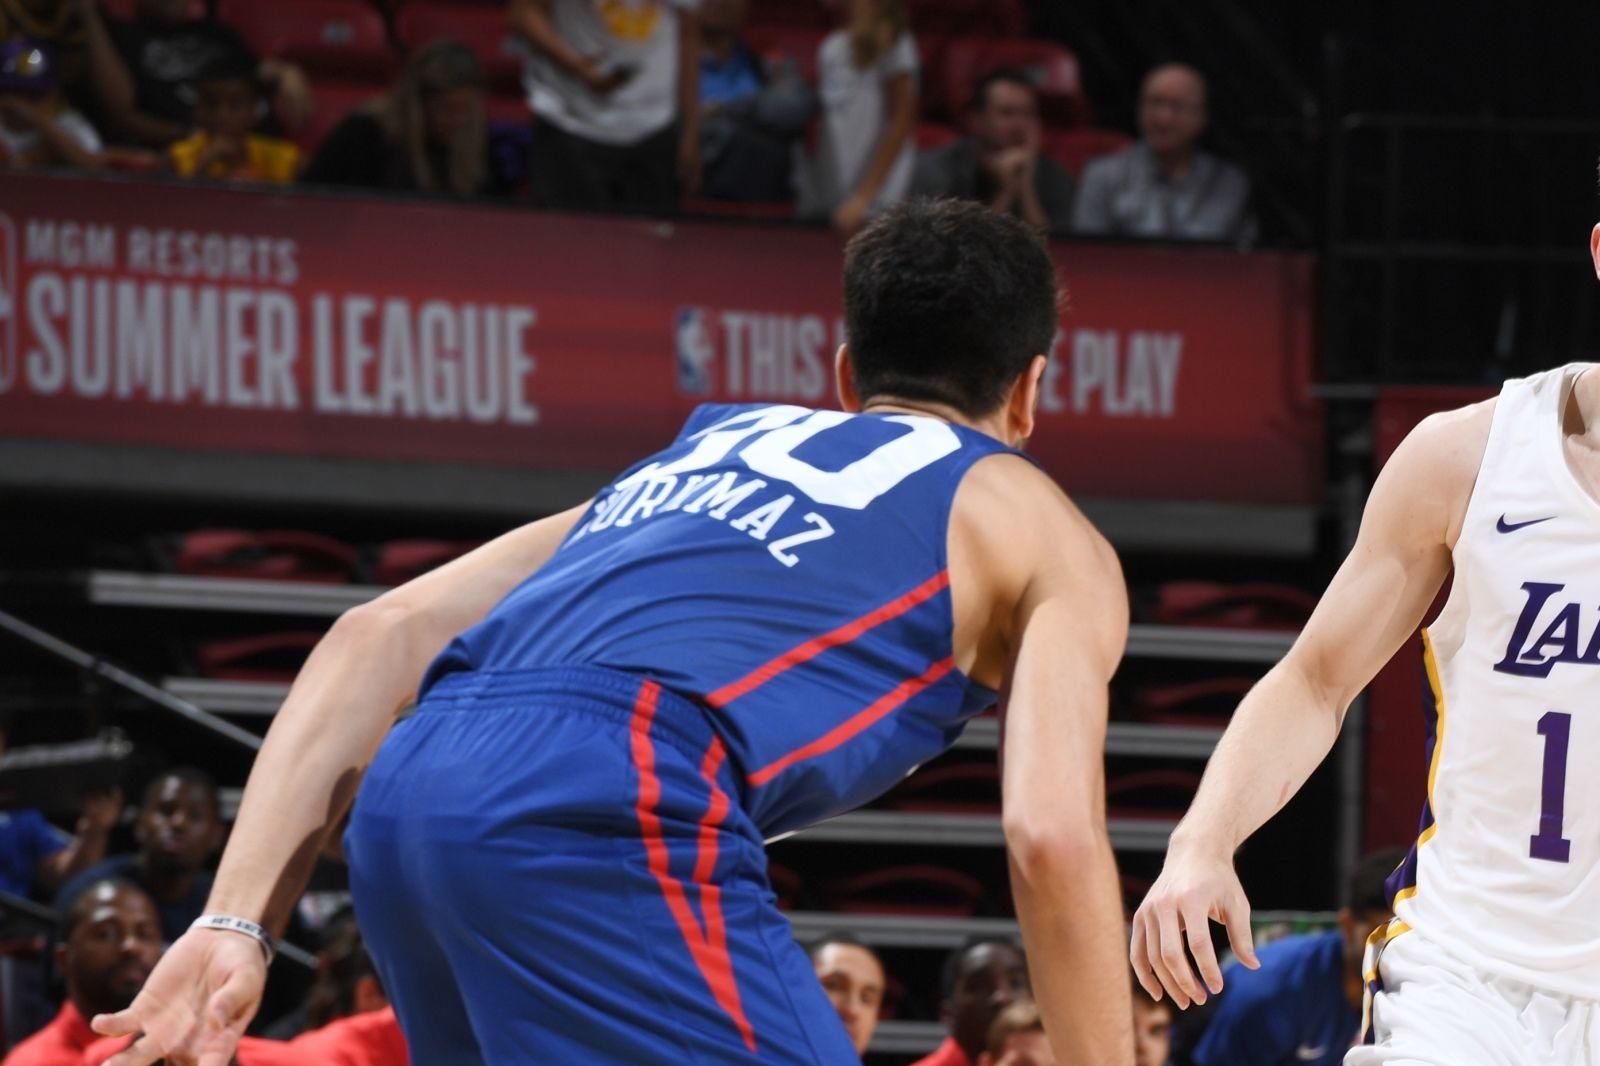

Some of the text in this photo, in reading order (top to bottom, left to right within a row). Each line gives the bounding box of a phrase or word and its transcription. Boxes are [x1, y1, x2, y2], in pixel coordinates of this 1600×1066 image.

[26, 218, 299, 285] MGM RESORTS
[26, 271, 539, 425] SUMMER LEAGUE
[720, 310, 827, 402] THIS
[1073, 328, 1185, 418] PLAY
